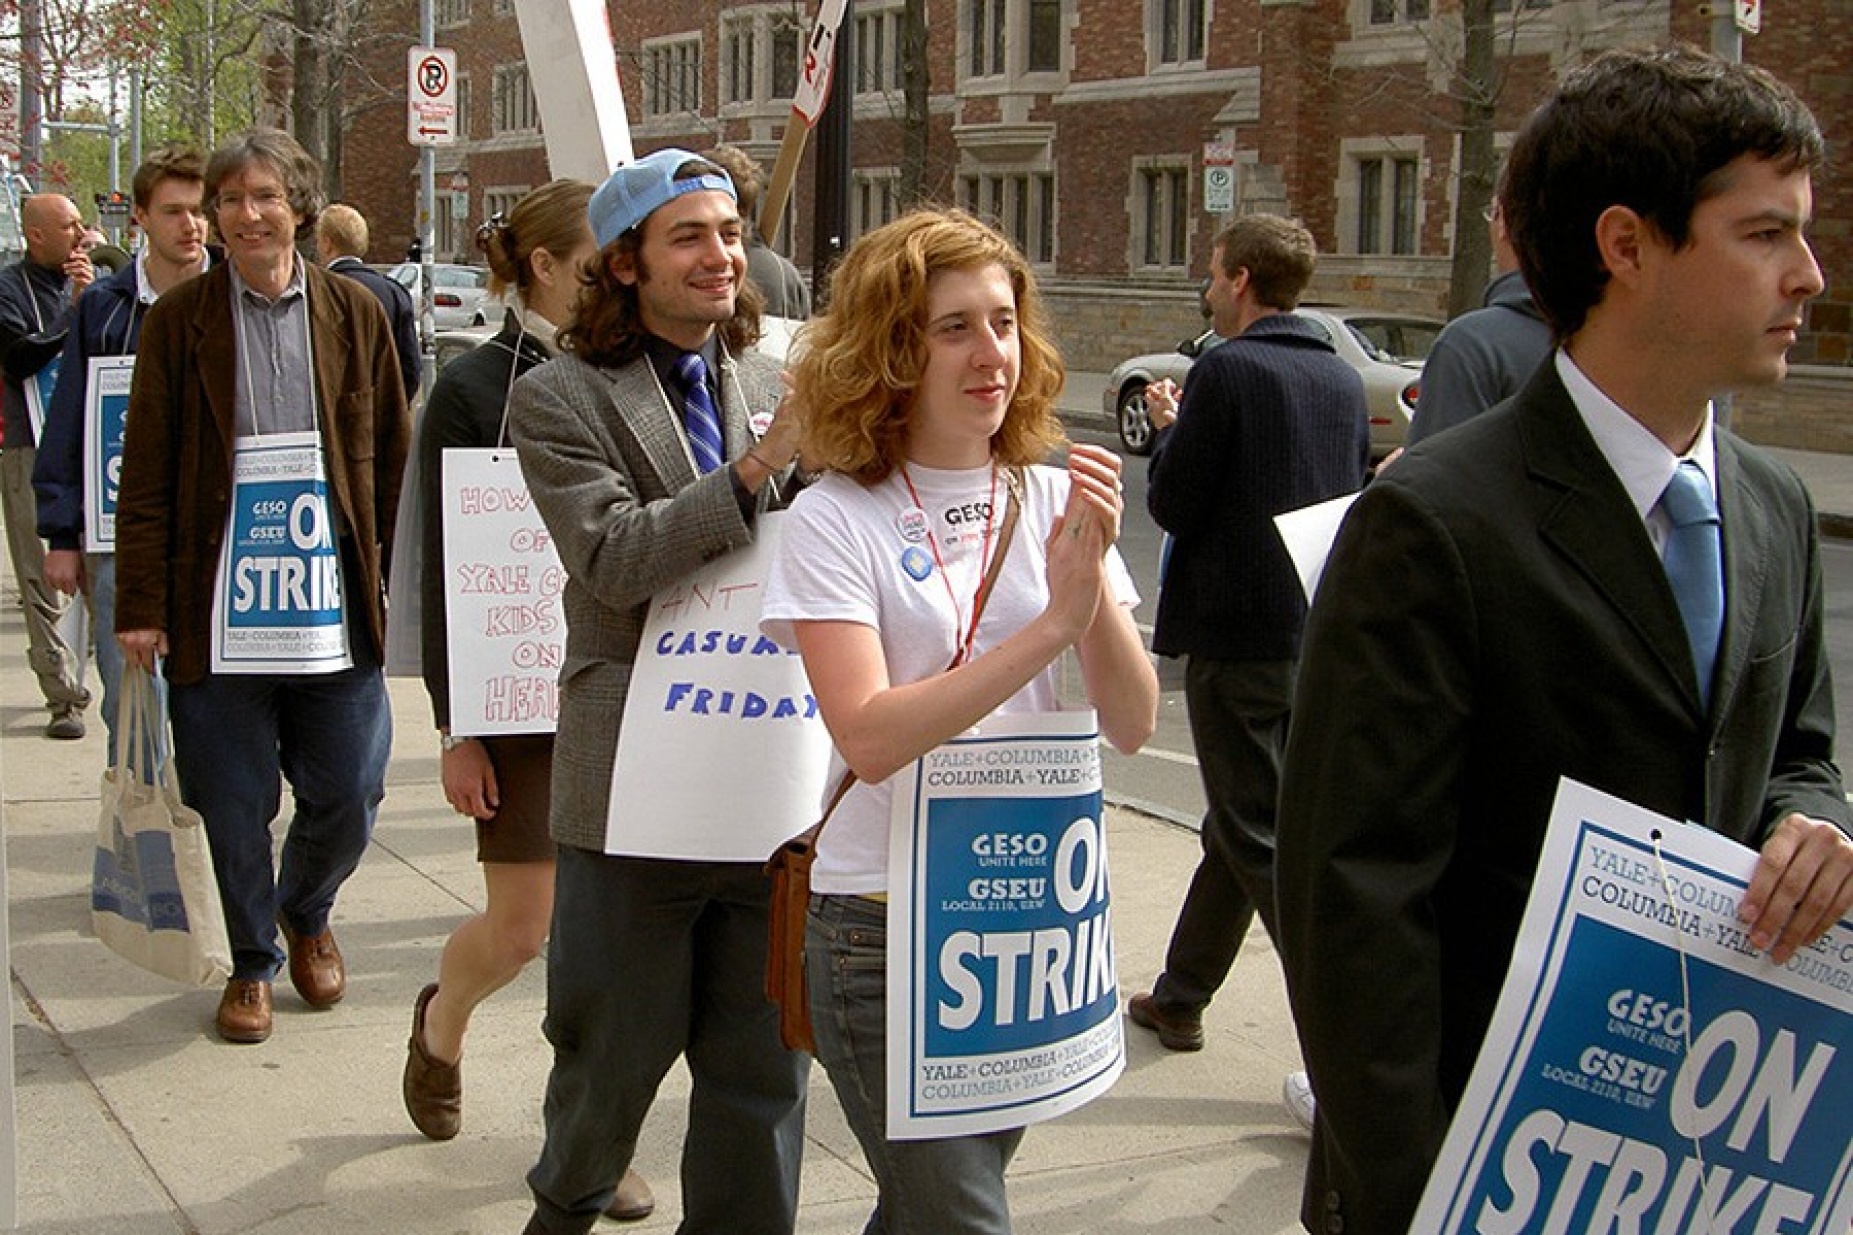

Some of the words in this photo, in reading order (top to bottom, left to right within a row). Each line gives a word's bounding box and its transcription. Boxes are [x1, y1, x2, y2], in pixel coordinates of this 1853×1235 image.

[460, 486, 530, 514] HOW
[944, 502, 994, 525] GESO
[510, 527, 550, 552] OF
[457, 563, 531, 594] YALE
[485, 600, 559, 637] KIDS
[513, 641, 561, 670] ON
[656, 630, 798, 656] CASUA
[971, 833, 1048, 856] GESO
[978, 857, 1015, 867] UNITE
[1018, 856, 1047, 867] HERE
[967, 877, 1047, 900] GSEU
[942, 900, 985, 912] LOCAL
[938, 906, 1116, 1031] STRIK
[1607, 1018, 1648, 1043] UNITE
[1541, 1063, 1590, 1091] LOCAL
[1579, 1046, 1668, 1094] GSEU
[1607, 989, 1690, 1037] GESO
[1670, 1009, 1837, 1165] ON
